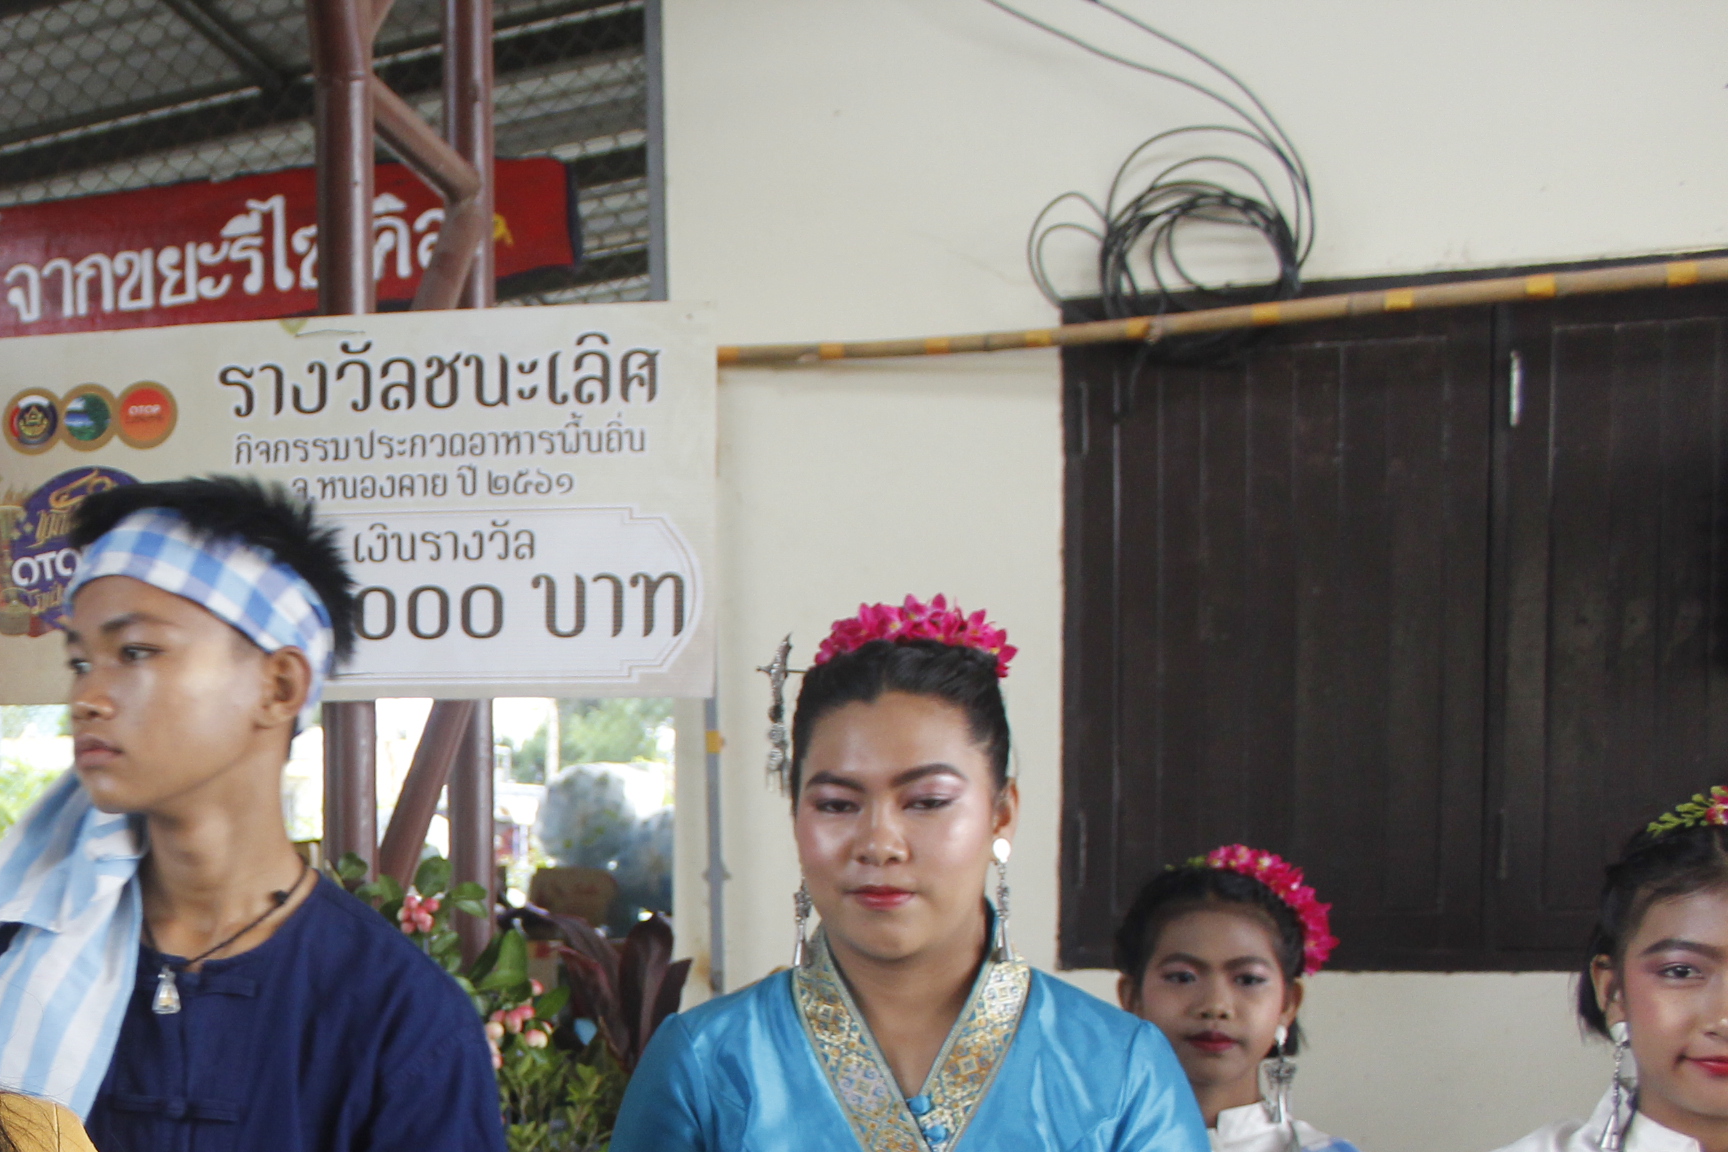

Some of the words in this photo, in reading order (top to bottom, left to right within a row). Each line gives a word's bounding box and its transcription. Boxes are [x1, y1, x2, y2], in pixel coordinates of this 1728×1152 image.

[219, 332, 660, 418] รางวัลชนะเลิศ
[457, 465, 478, 496] ปี
[352, 519, 536, 563] เงินรางวัล
[11, 549, 80, 587] OTO
[530, 571, 686, 638] บาท
